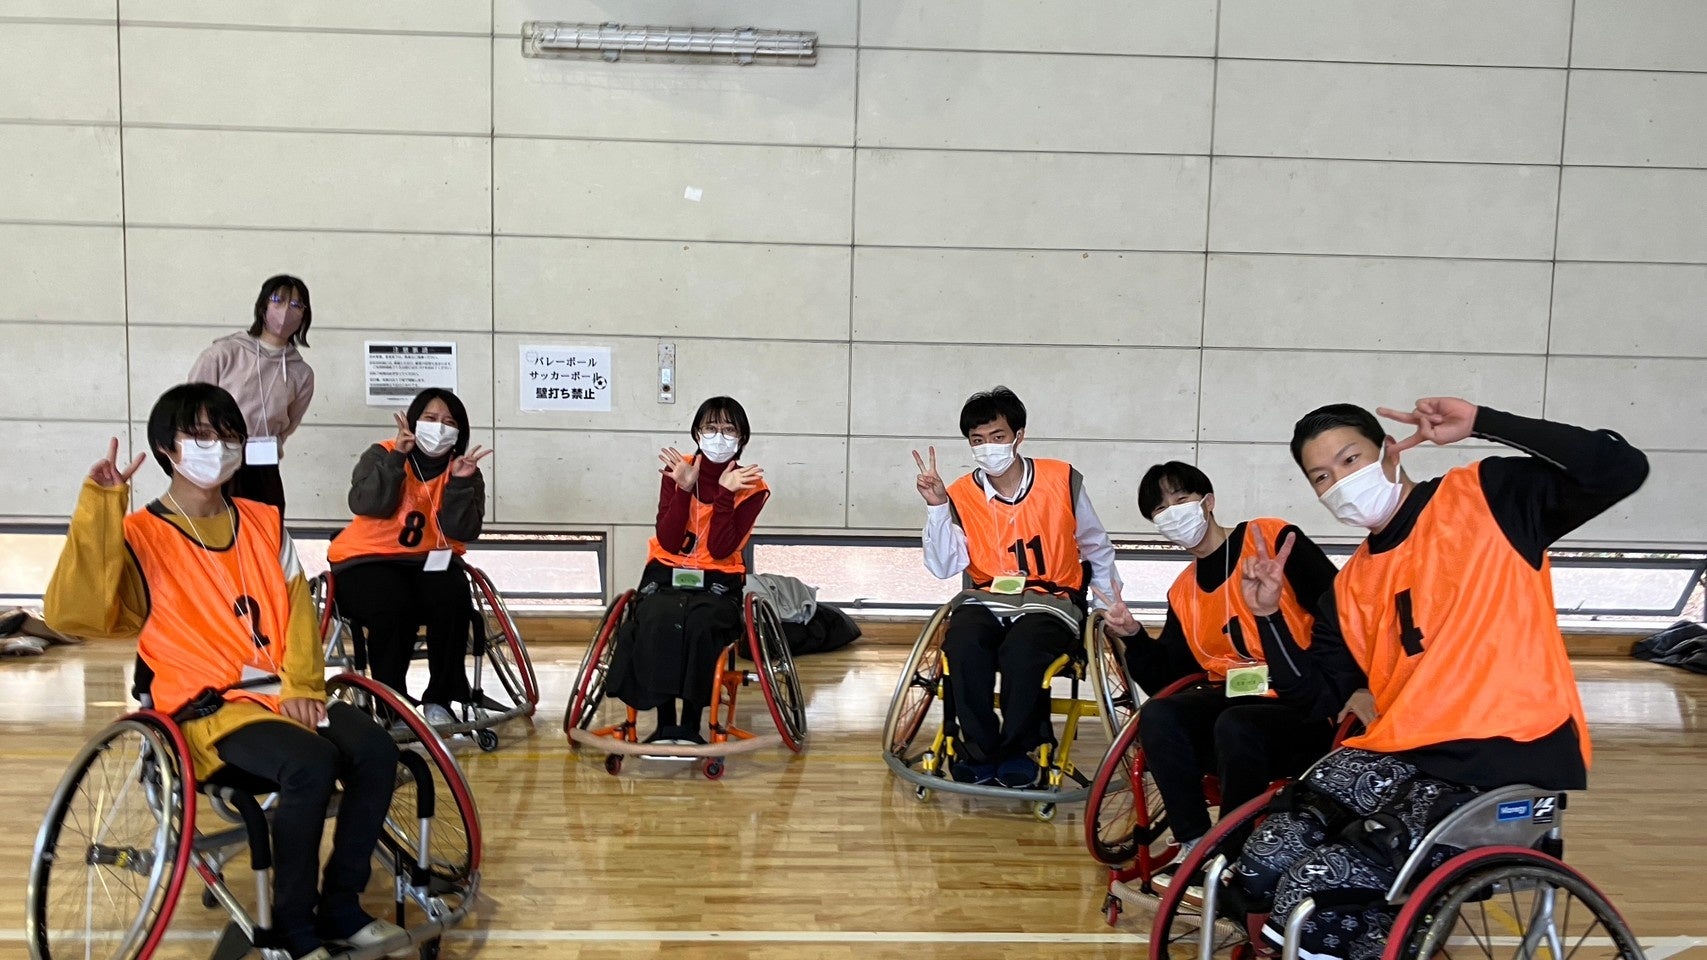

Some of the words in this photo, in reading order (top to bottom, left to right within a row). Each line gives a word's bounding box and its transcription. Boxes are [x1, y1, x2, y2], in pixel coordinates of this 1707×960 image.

[535, 357, 597, 367] バレーボール
[529, 371, 600, 383] サッカーボール
[536, 387, 595, 400] 壁打ち禁止
[398, 510, 426, 548] 8
[1007, 534, 1047, 577] 11
[233, 594, 271, 650] 2
